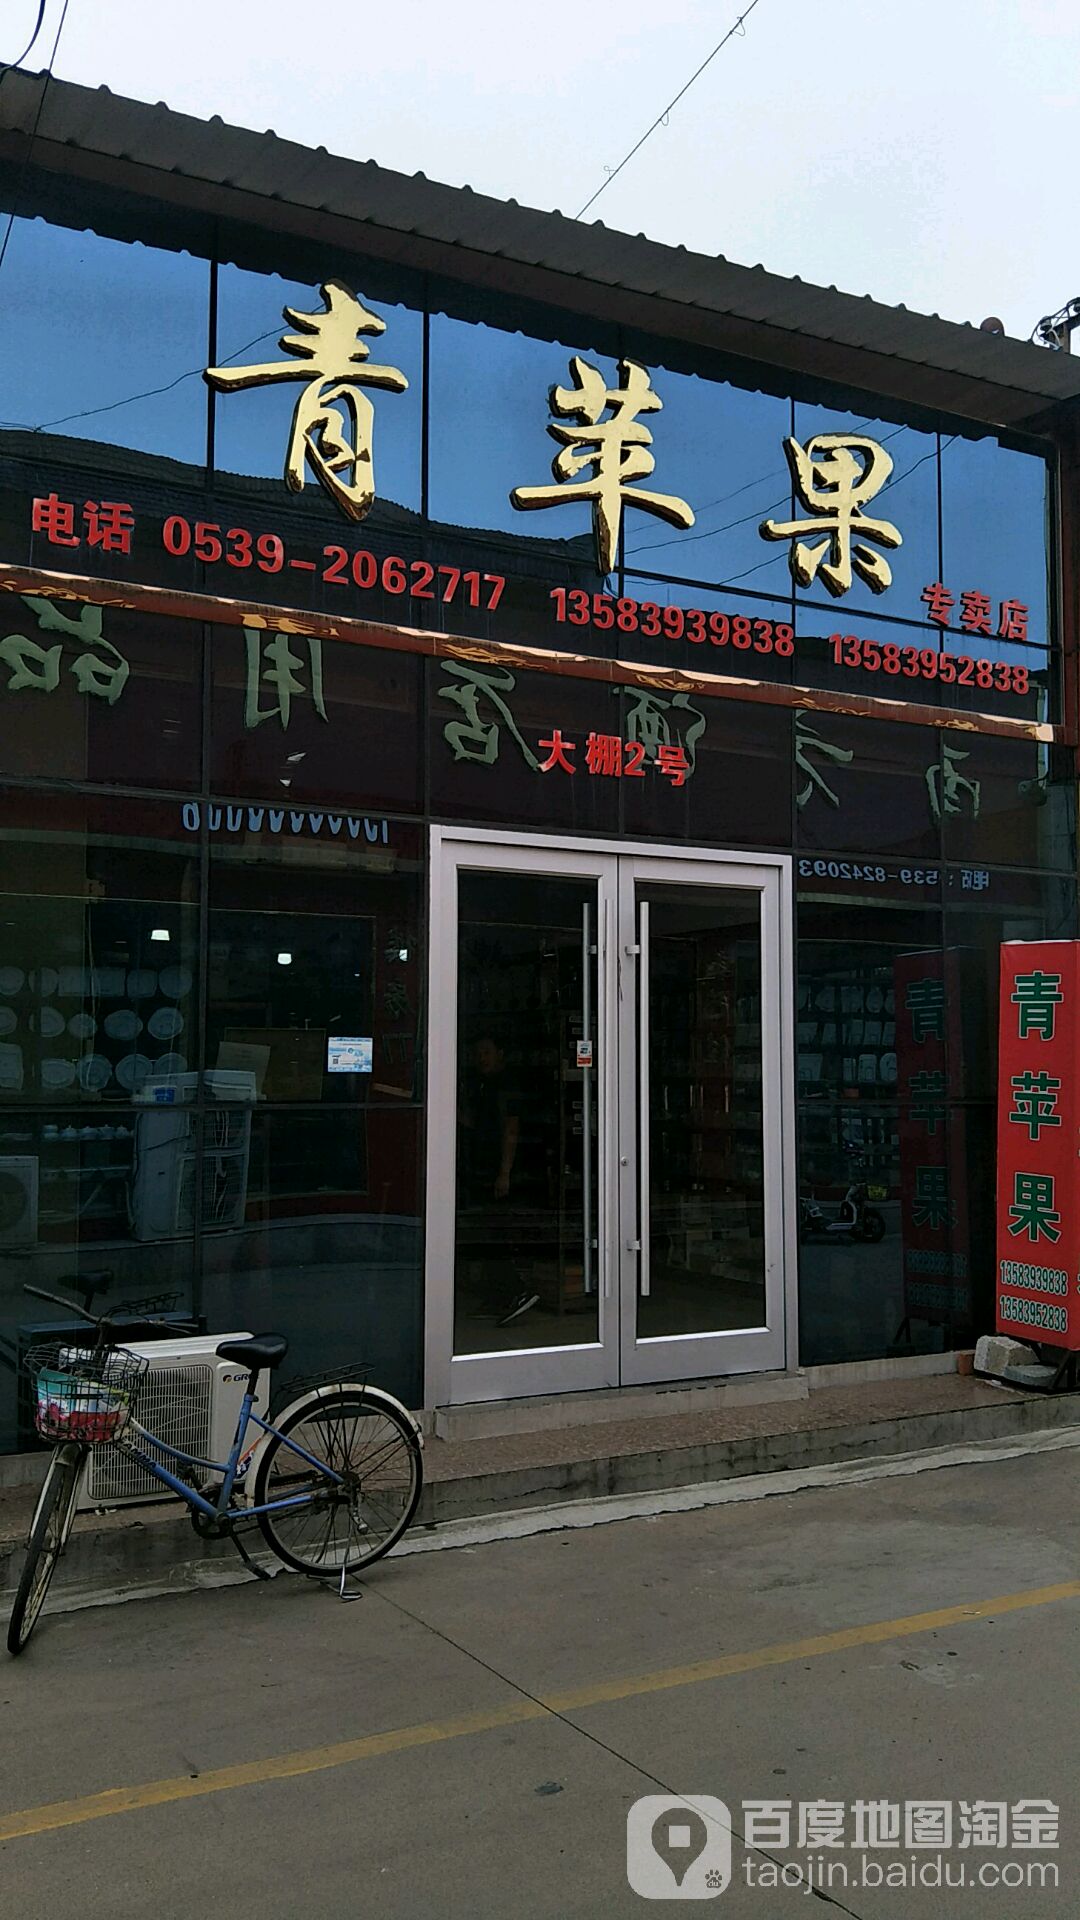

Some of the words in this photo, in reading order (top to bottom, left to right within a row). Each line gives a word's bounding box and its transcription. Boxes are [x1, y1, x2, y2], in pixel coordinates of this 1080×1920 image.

[204, 278, 904, 597] 青苹果
[32, 493, 135, 555] 电话
[162, 515, 506, 612] 0539-2062717
[550, 587, 796, 657] 13583939838
[828, 633, 1030, 695] 13583952838
[921, 582, 1030, 641] 专卖店
[537, 729, 690, 788] 大棚2号
[1008, 970, 1063, 1243] 青苹果
[1000, 1260, 1069, 1296] 13583939838
[1000, 1295, 1069, 1333] 13583952838
